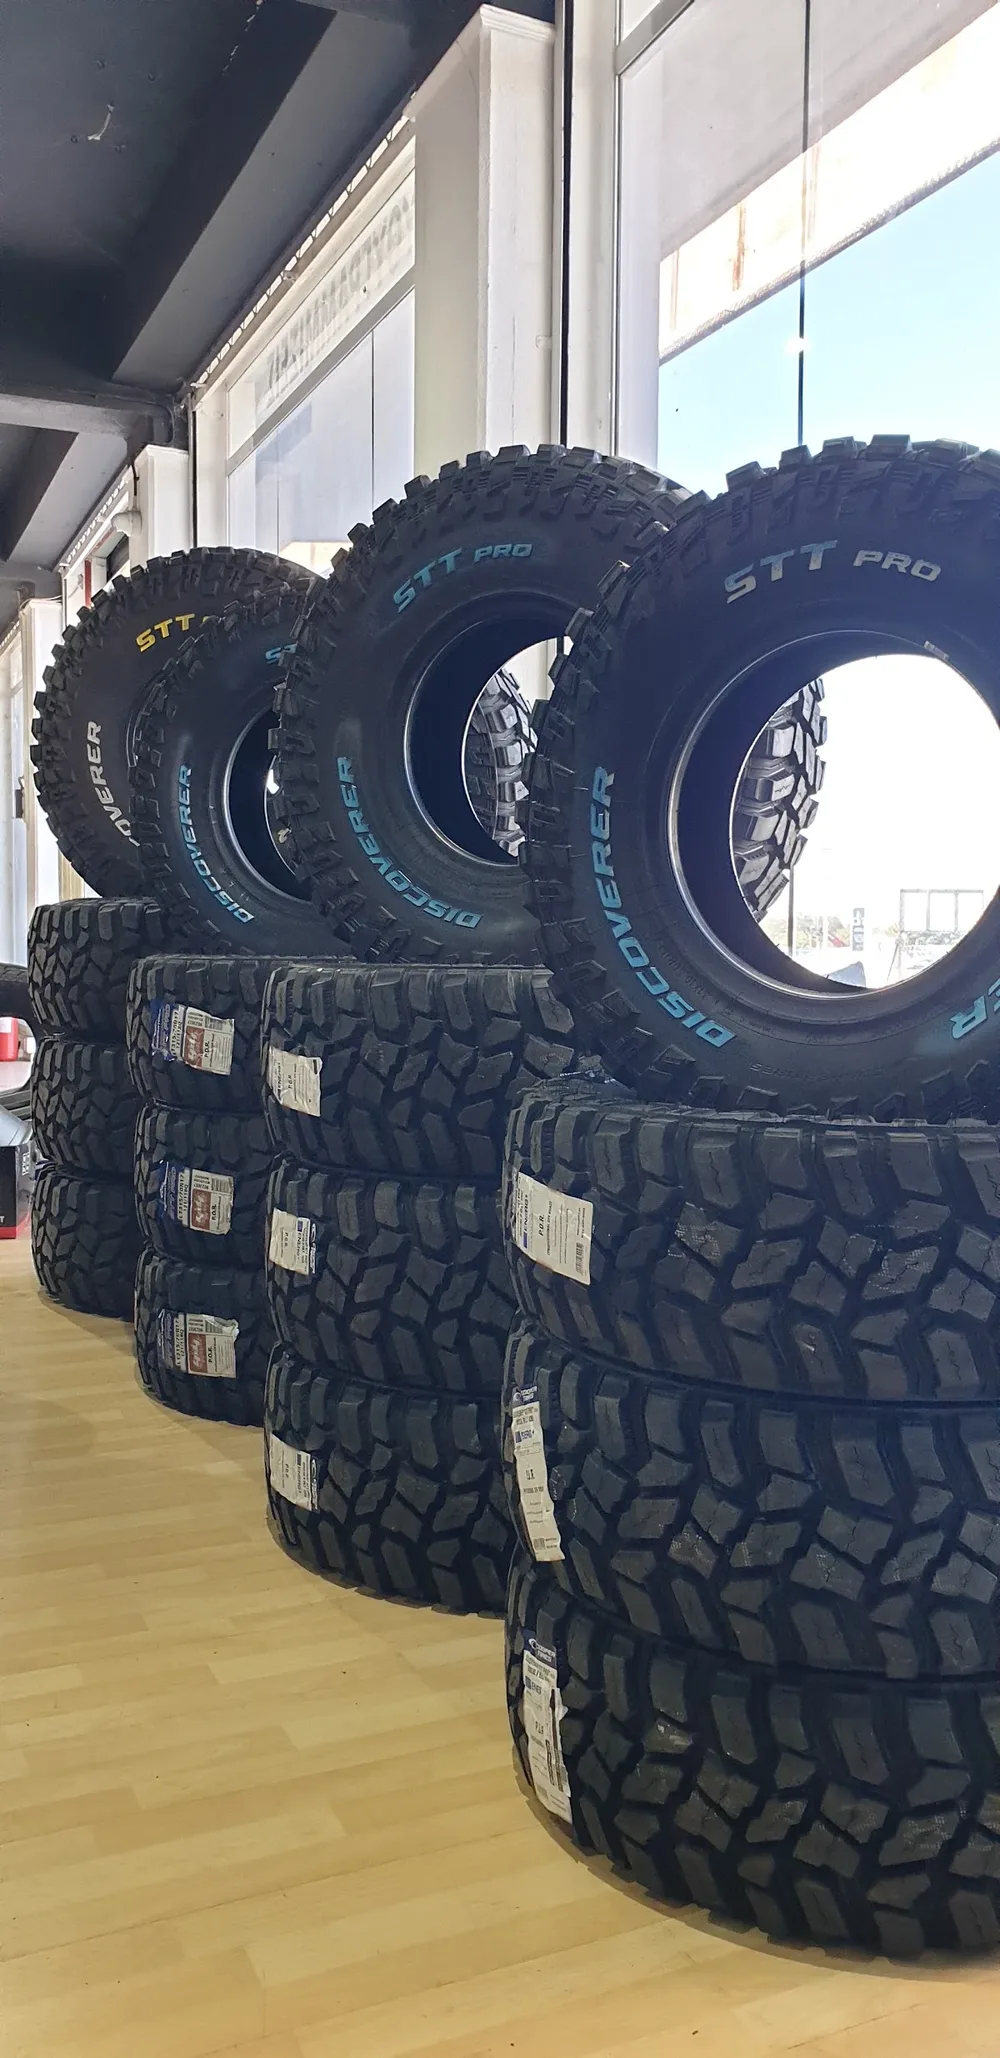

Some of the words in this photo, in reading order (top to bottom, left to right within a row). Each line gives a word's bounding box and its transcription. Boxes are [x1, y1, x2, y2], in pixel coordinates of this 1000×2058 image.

[136, 613, 196, 653] STT
[393, 547, 462, 613] STT
[474, 543, 533, 563] PRO
[724, 540, 838, 604] STT
[853, 550, 942, 582] PRO
[87, 721, 141, 847] OVERER
[178, 764, 255, 924] DISCOVERER
[337, 756, 485, 929] DISCOVERER
[590, 766, 737, 1048] DISCOVERER
